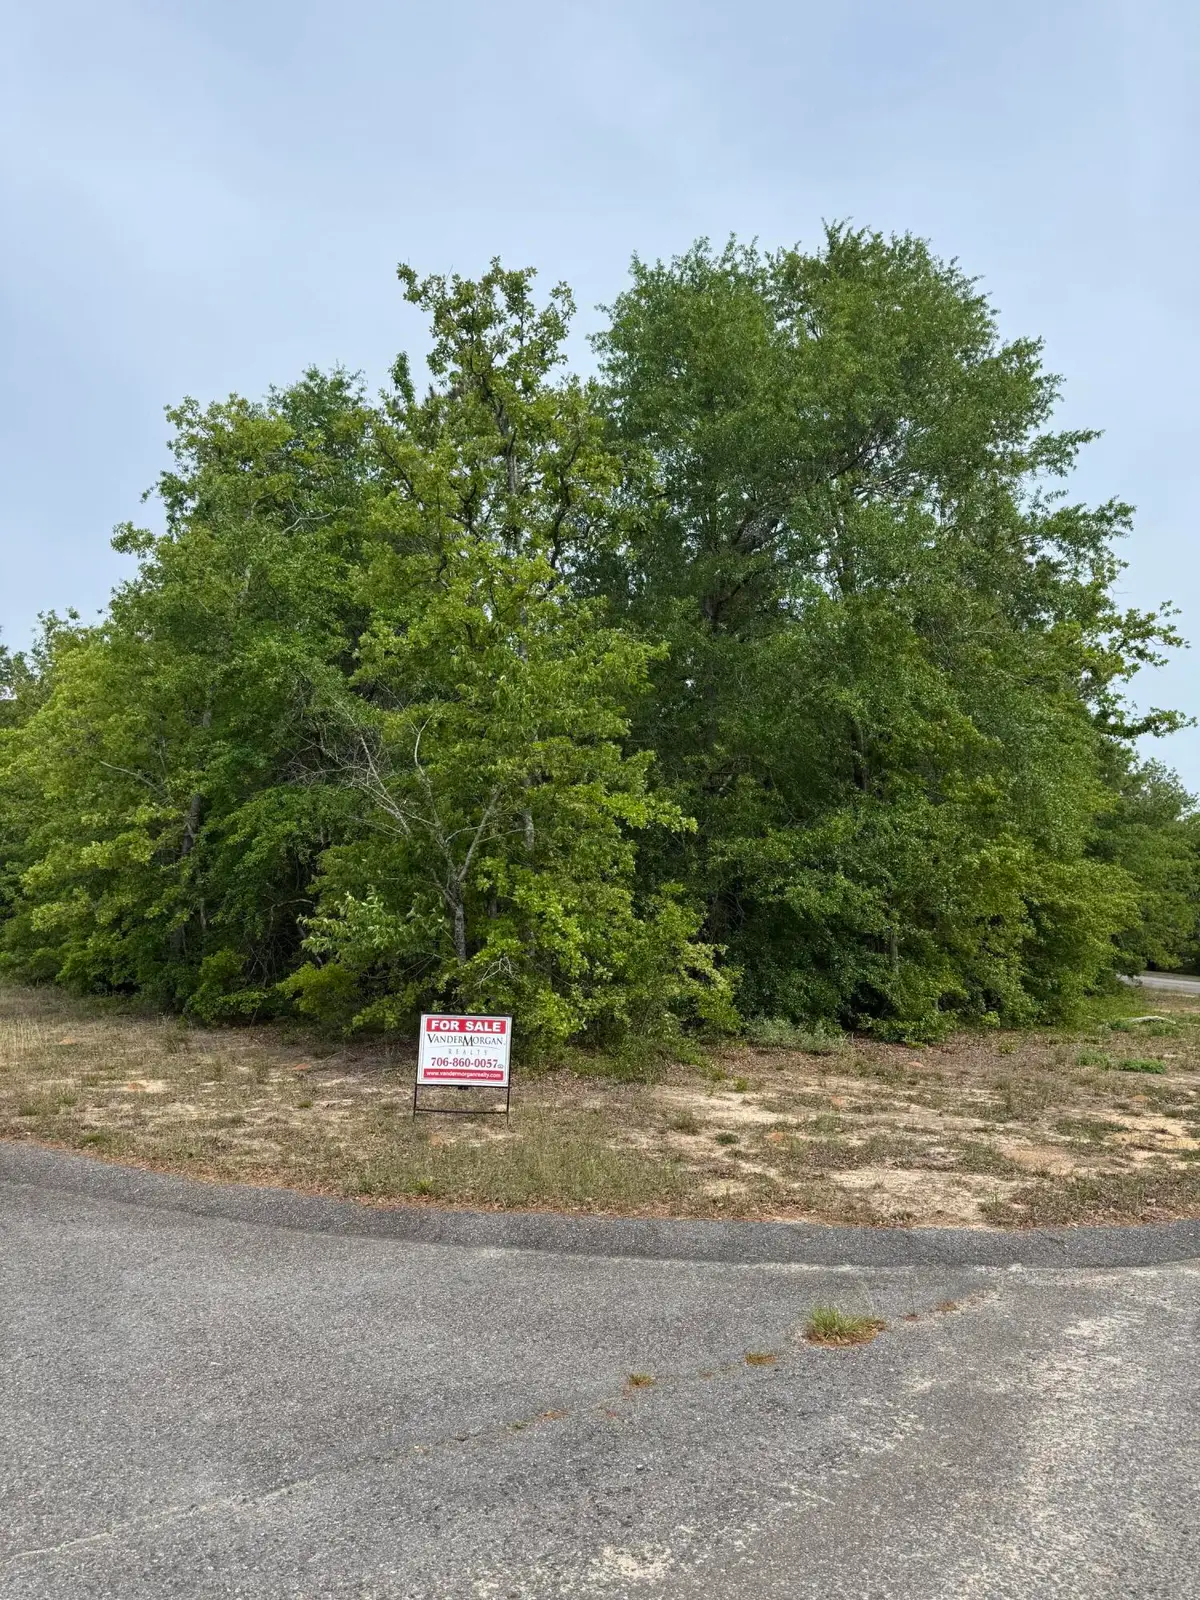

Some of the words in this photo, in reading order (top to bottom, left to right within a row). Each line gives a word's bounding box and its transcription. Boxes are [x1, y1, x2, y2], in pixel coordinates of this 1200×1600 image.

[431, 1020, 460, 1030] FOR
[465, 1021, 501, 1032] SALE
[448, 1048, 488, 1056] REALTY
[431, 1057, 498, 1068] 706-860-0057
[426, 1070, 501, 1079] www.vandermorganrealty.com
